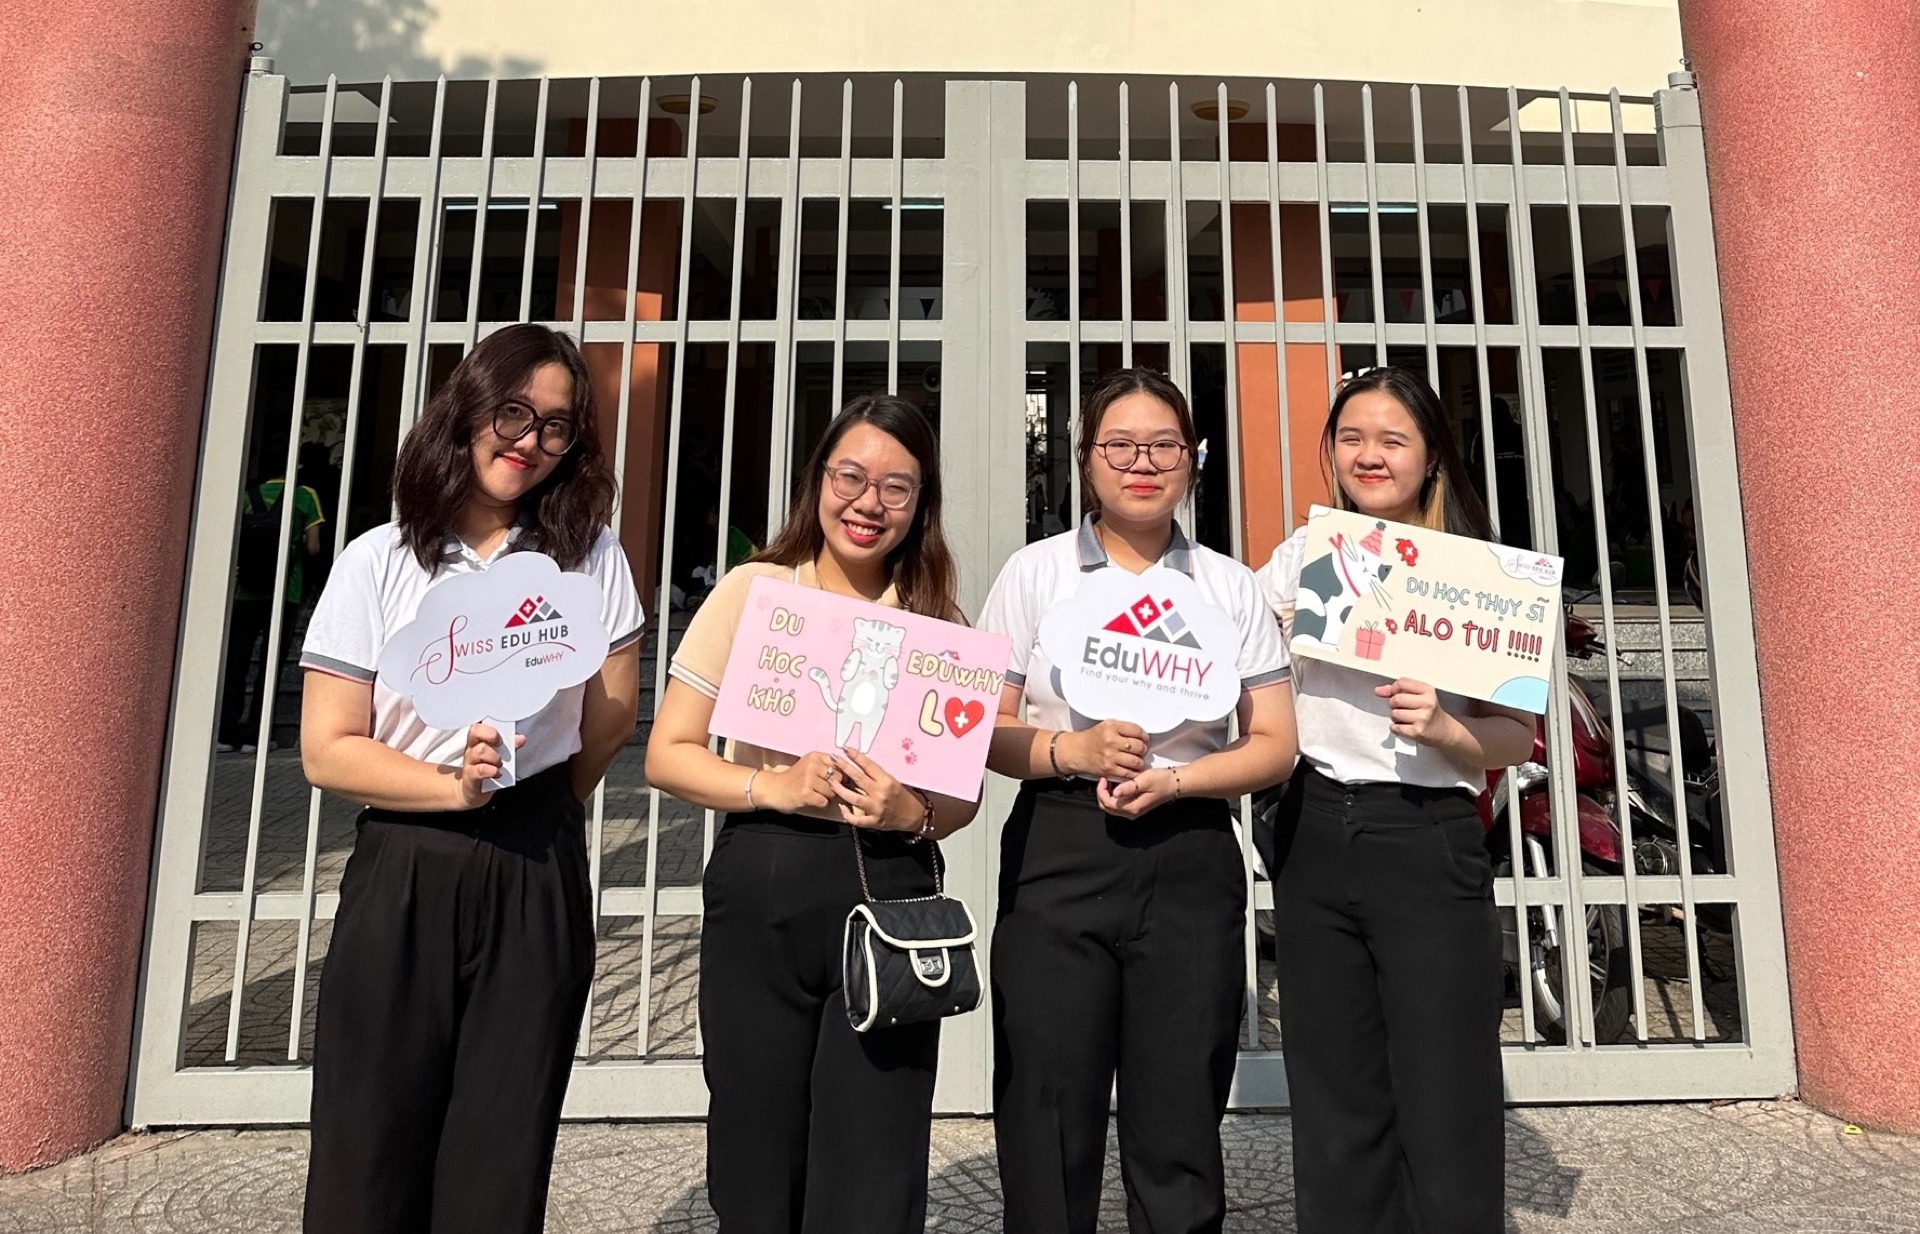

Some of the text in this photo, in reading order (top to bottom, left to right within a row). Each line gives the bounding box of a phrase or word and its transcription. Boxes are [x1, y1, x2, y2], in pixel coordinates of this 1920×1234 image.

[1406, 576, 1429, 596] DU
[1433, 582, 1470, 610] HỌC
[1526, 596, 1550, 623] SĨ
[501, 632, 531, 649] EDU
[538, 624, 569, 642] HUB
[769, 607, 804, 636] DU
[1404, 609, 1453, 640] ALO
[1507, 630, 1542, 662] !!!!!
[525, 652, 564, 668] EduWHY
[758, 646, 806, 683] HỌC
[906, 649, 1004, 695] EDUWHY
[1083, 636, 1213, 687] EduWHY
[747, 684, 796, 716] KHÓ
[1080, 667, 1210, 701] Find your why and thrive
